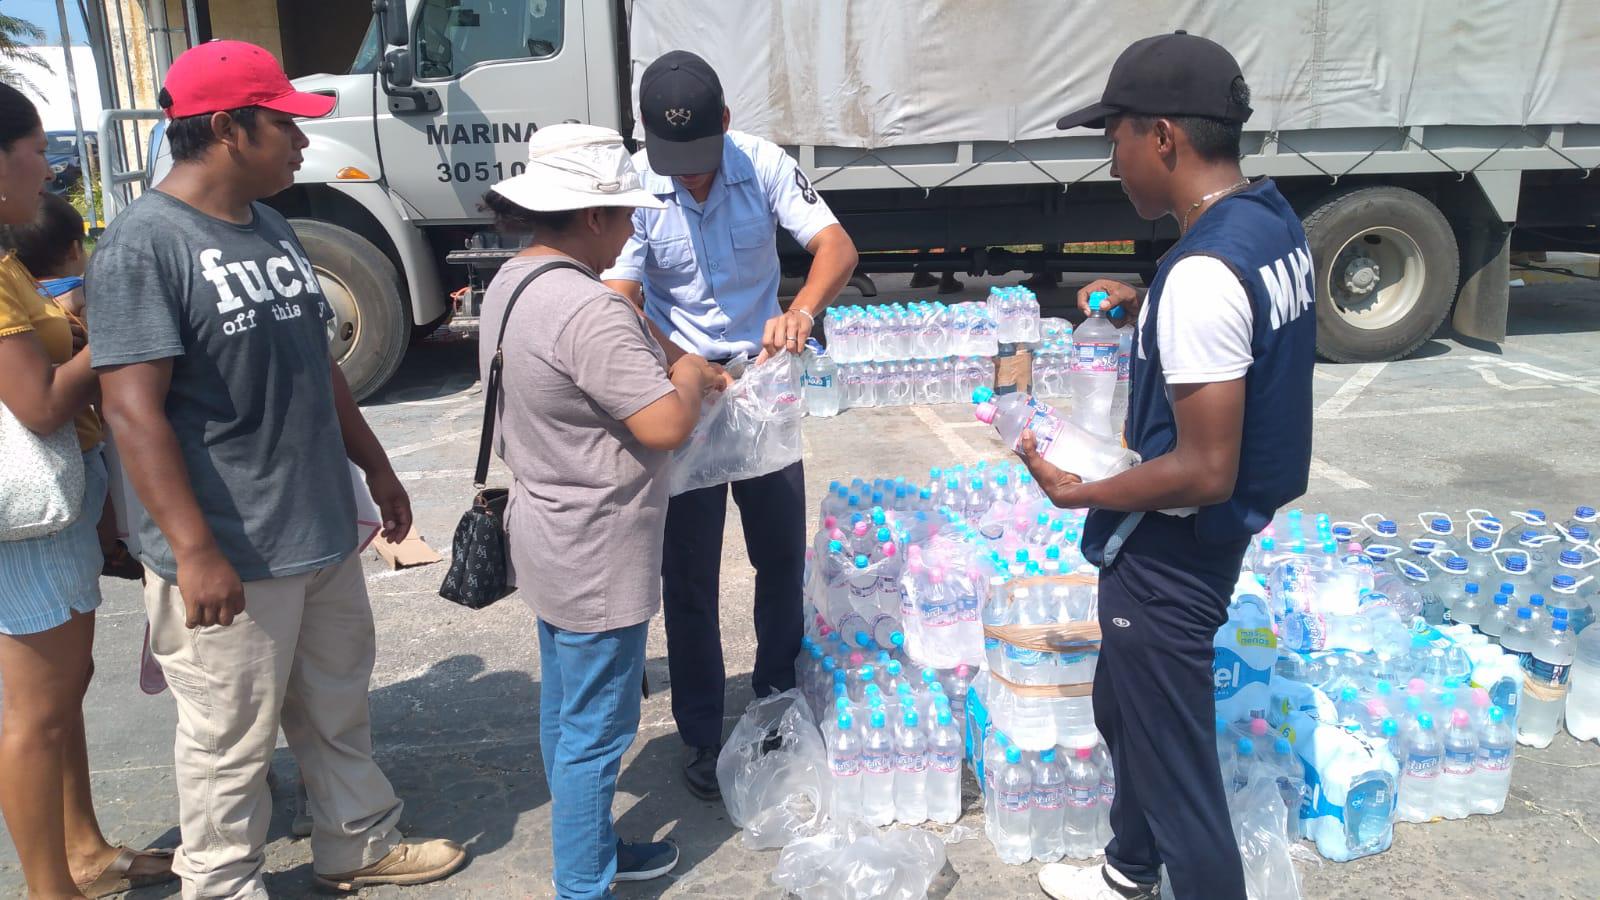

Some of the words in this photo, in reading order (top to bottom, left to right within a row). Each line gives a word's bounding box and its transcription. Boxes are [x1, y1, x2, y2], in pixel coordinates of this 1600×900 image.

[199, 239, 321, 314] fuck
[222, 309, 257, 335] off
[271, 302, 302, 321] this
[1213, 661, 1240, 688] el
